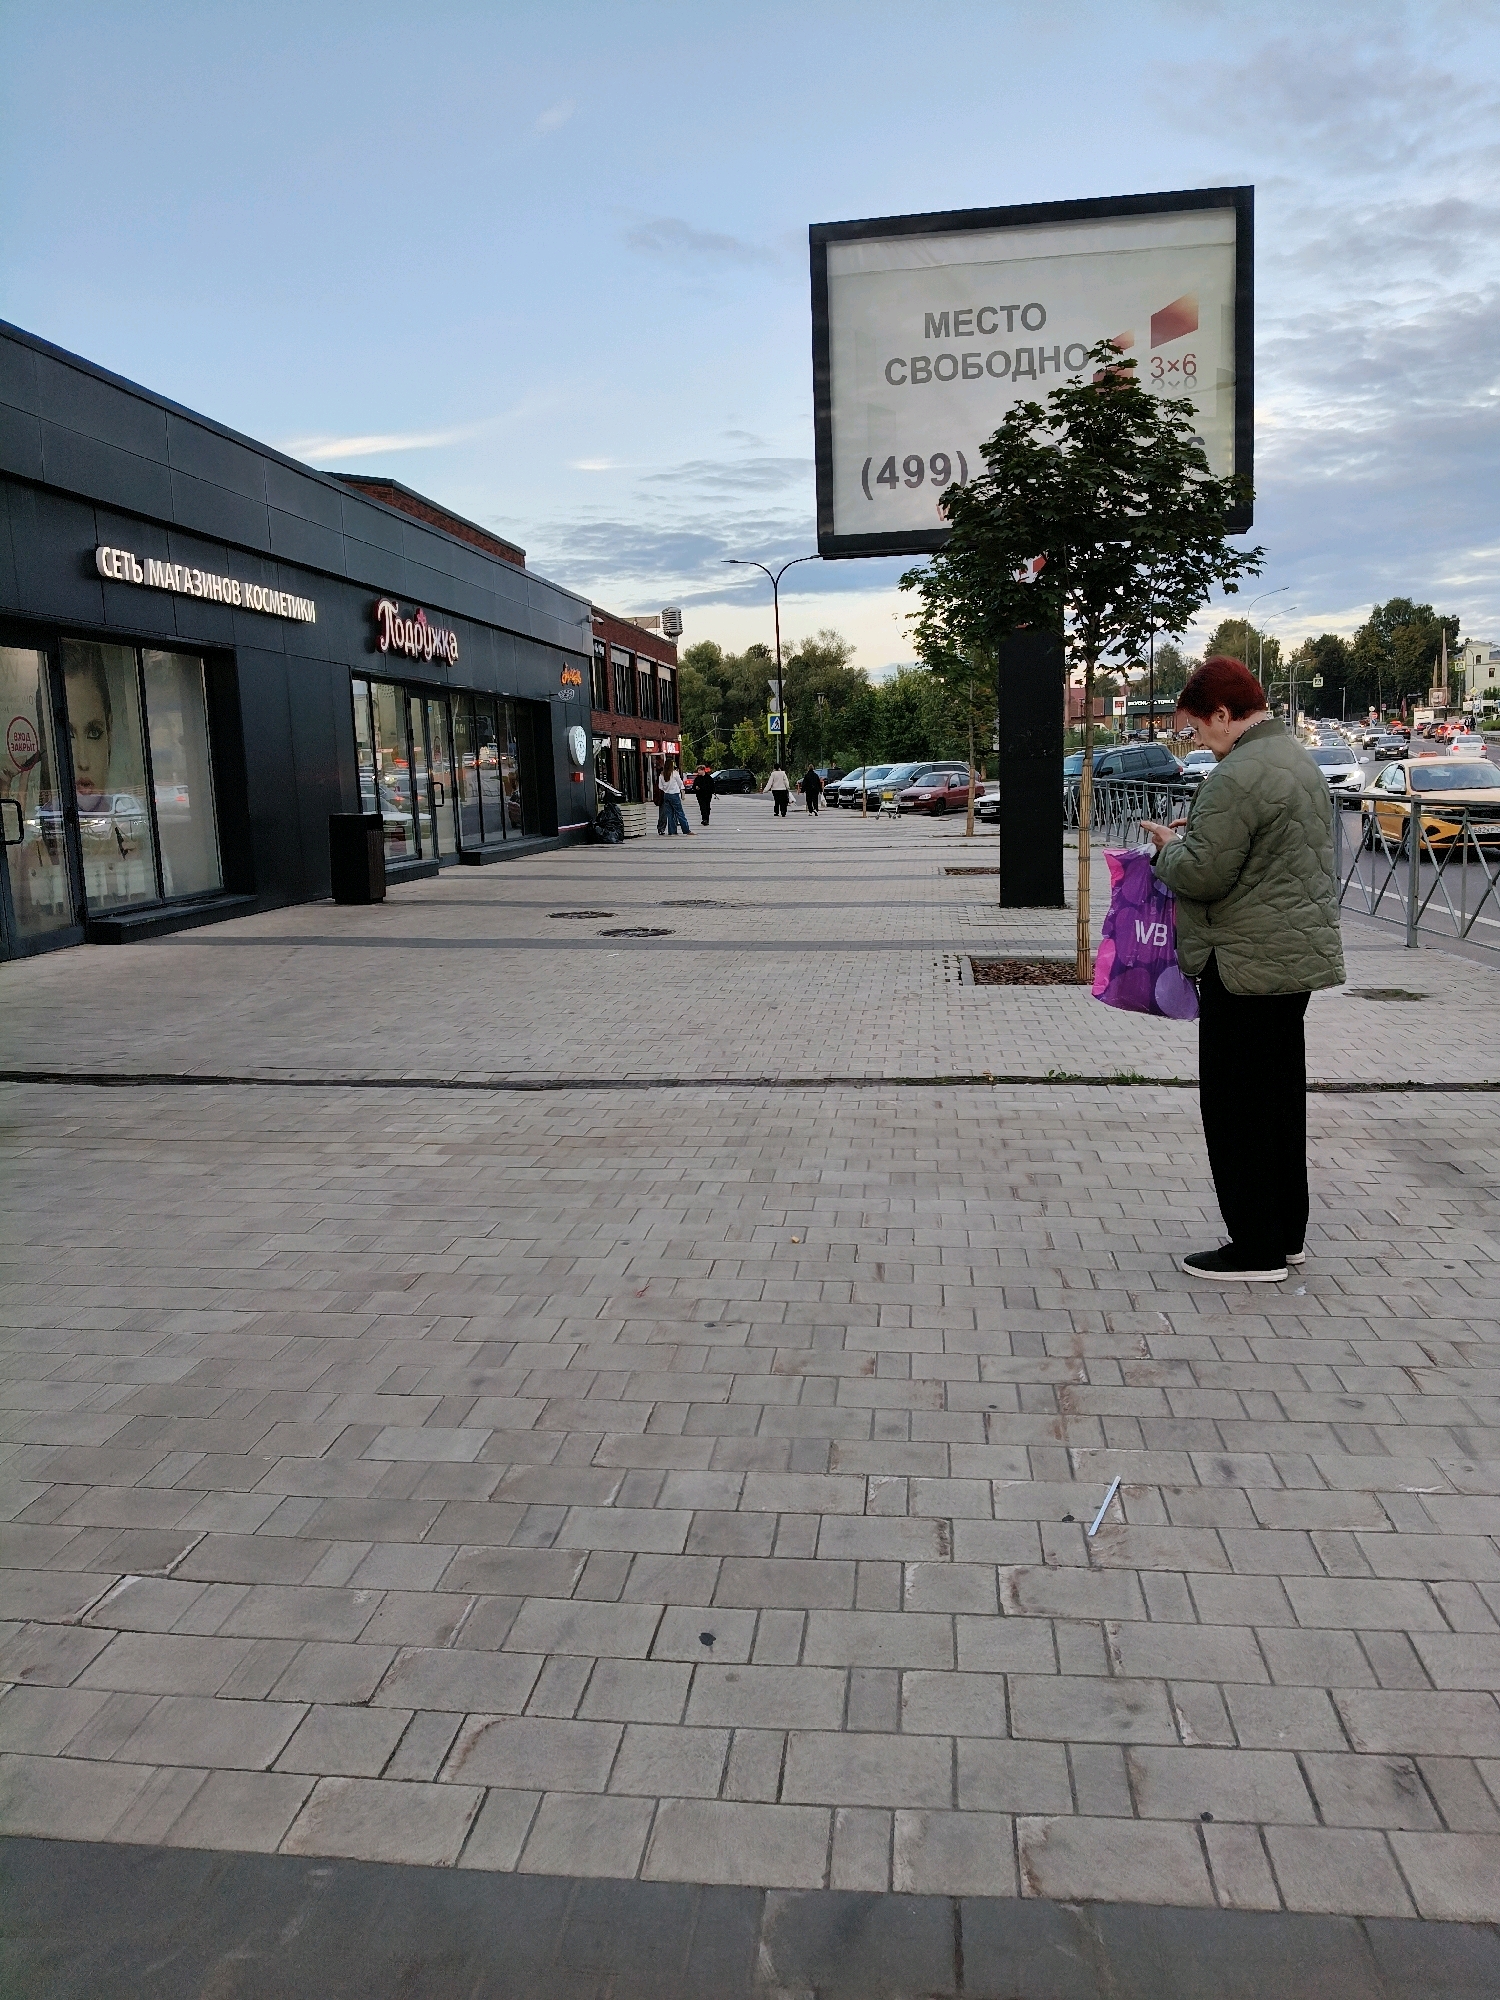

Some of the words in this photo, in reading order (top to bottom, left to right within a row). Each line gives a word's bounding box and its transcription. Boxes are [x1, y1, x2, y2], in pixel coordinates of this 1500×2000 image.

[924, 302, 1047, 339] МЕСТО
[884, 342, 1089, 386] СВОБОДНО
[861, 450, 969, 501] (499)
[96, 546, 144, 584] СЕТЬ
[144, 557, 242, 606] МАГАЗИНОВ
[241, 582, 317, 624] КОСМЕТИКИ
[377, 599, 459, 667] Подружка
[10, 742, 36, 752] ЗАКРЫТ
[13, 731, 31, 743] ВХОД
[1134, 919, 1168, 947] WB
